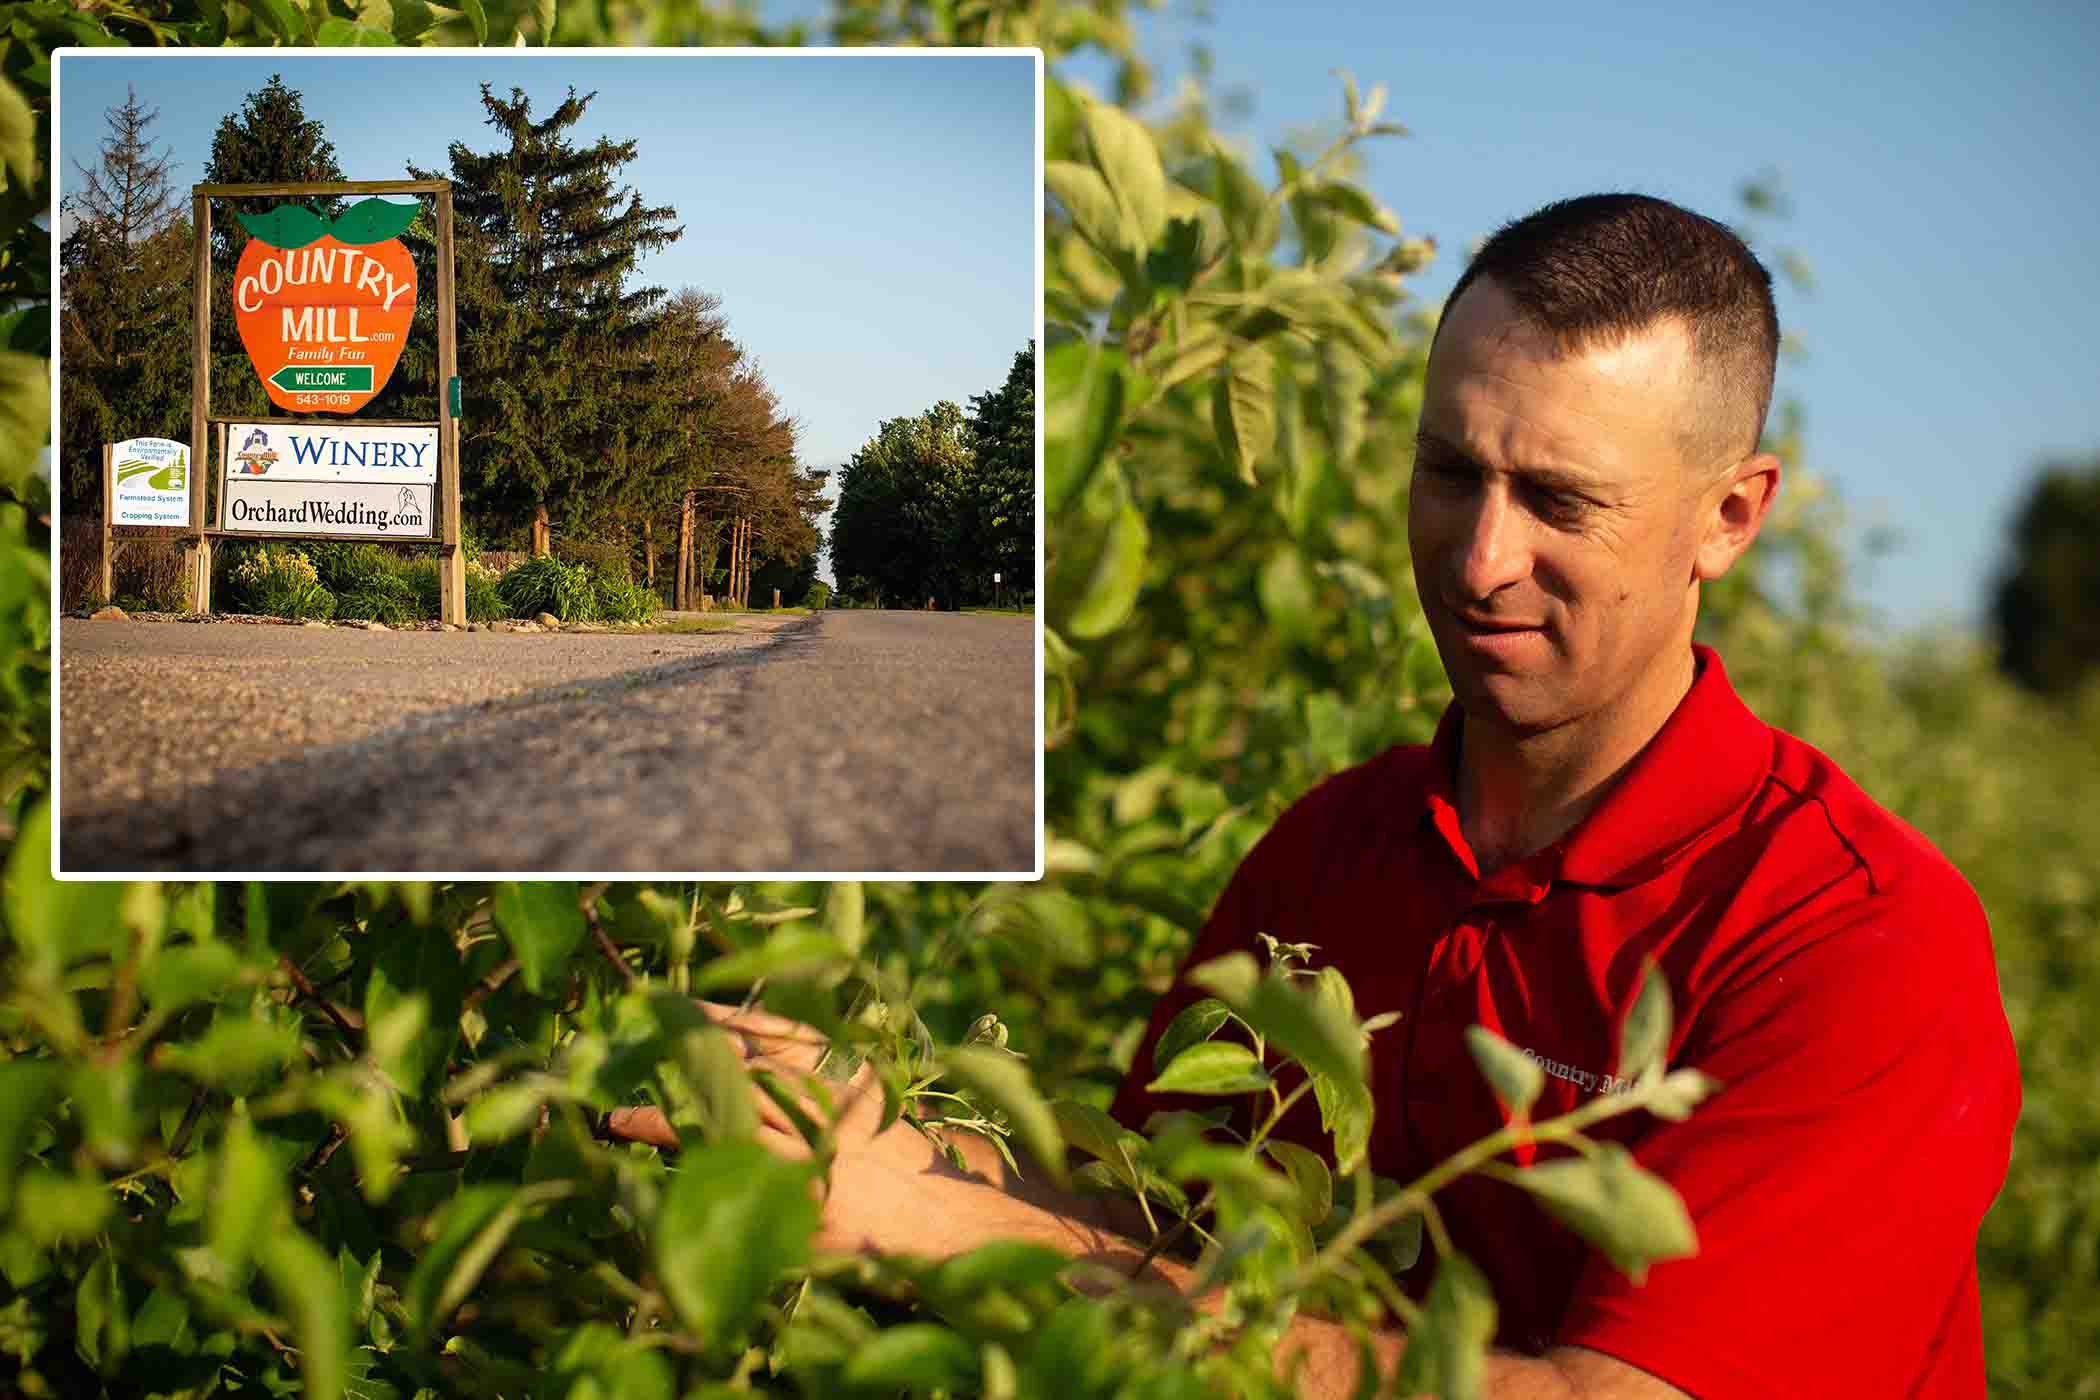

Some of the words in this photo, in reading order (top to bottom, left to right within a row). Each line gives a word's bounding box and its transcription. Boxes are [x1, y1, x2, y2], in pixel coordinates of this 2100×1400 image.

[238, 248, 411, 312] COUNTRY
[288, 347, 335, 362] Family
[339, 347, 366, 360] Fun
[295, 372, 347, 385] WELCOME
[296, 394, 350, 405] 543-1019
[120, 494, 156, 502] Farmstead
[157, 495, 184, 503] System
[121, 511, 152, 520] Cropping
[154, 512, 180, 520] System
[232, 498, 423, 530] OrchardWedding.com
[1522, 1047, 1598, 1092] Country
